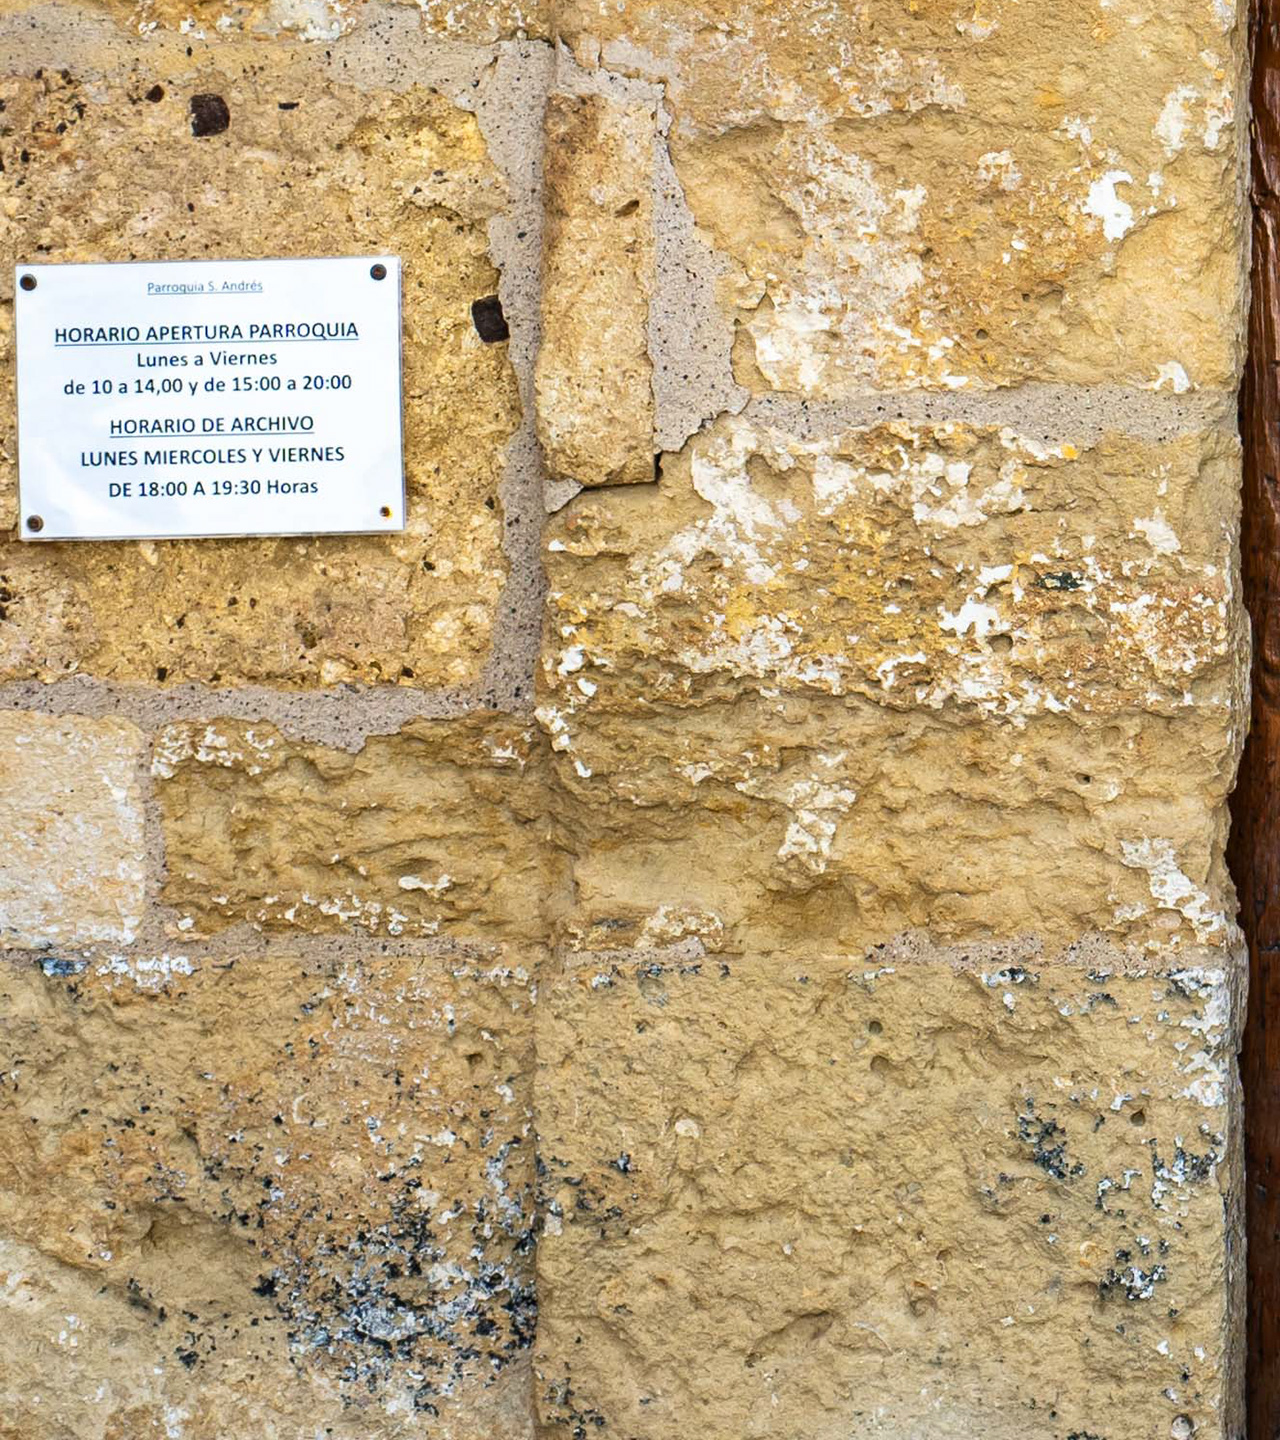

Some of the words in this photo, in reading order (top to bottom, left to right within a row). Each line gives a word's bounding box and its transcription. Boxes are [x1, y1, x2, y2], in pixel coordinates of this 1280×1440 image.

[147, 282, 204, 294] Parroquia
[208, 281, 218, 291] S.
[222, 280, 263, 291] Andrés
[55, 327, 140, 342] HORARIO
[146, 325, 243, 340] APERTURA
[250, 322, 359, 339] PARROQUIA
[137, 352, 188, 367] Lunes
[194, 354, 204, 366] a
[210, 350, 277, 366] Viernes
[64, 379, 85, 395] de
[91, 379, 113, 395] 10
[118, 382, 128, 394] a
[134, 378, 183, 397] 14,00
[188, 382, 198, 396] y
[205, 376, 226, 393] de
[232, 376, 281, 392] 15:00
[287, 379, 296, 390] a
[303, 374, 352, 390] 20:00
[110, 418, 195, 434] HORARIO
[201, 417, 226, 433] DE
[231, 416, 314, 431] ARCHIVO
[81, 451, 138, 467] LUNES
[144, 449, 247, 465] MIERCOLES
[252, 448, 263, 463] Y
[269, 447, 344, 462] VIERNES
[109, 482, 131, 497] DE
[138, 481, 188, 496] 18:00
[193, 481, 206, 495] A
[212, 480, 261, 495] 19:30
[267, 479, 318, 494] Horas
